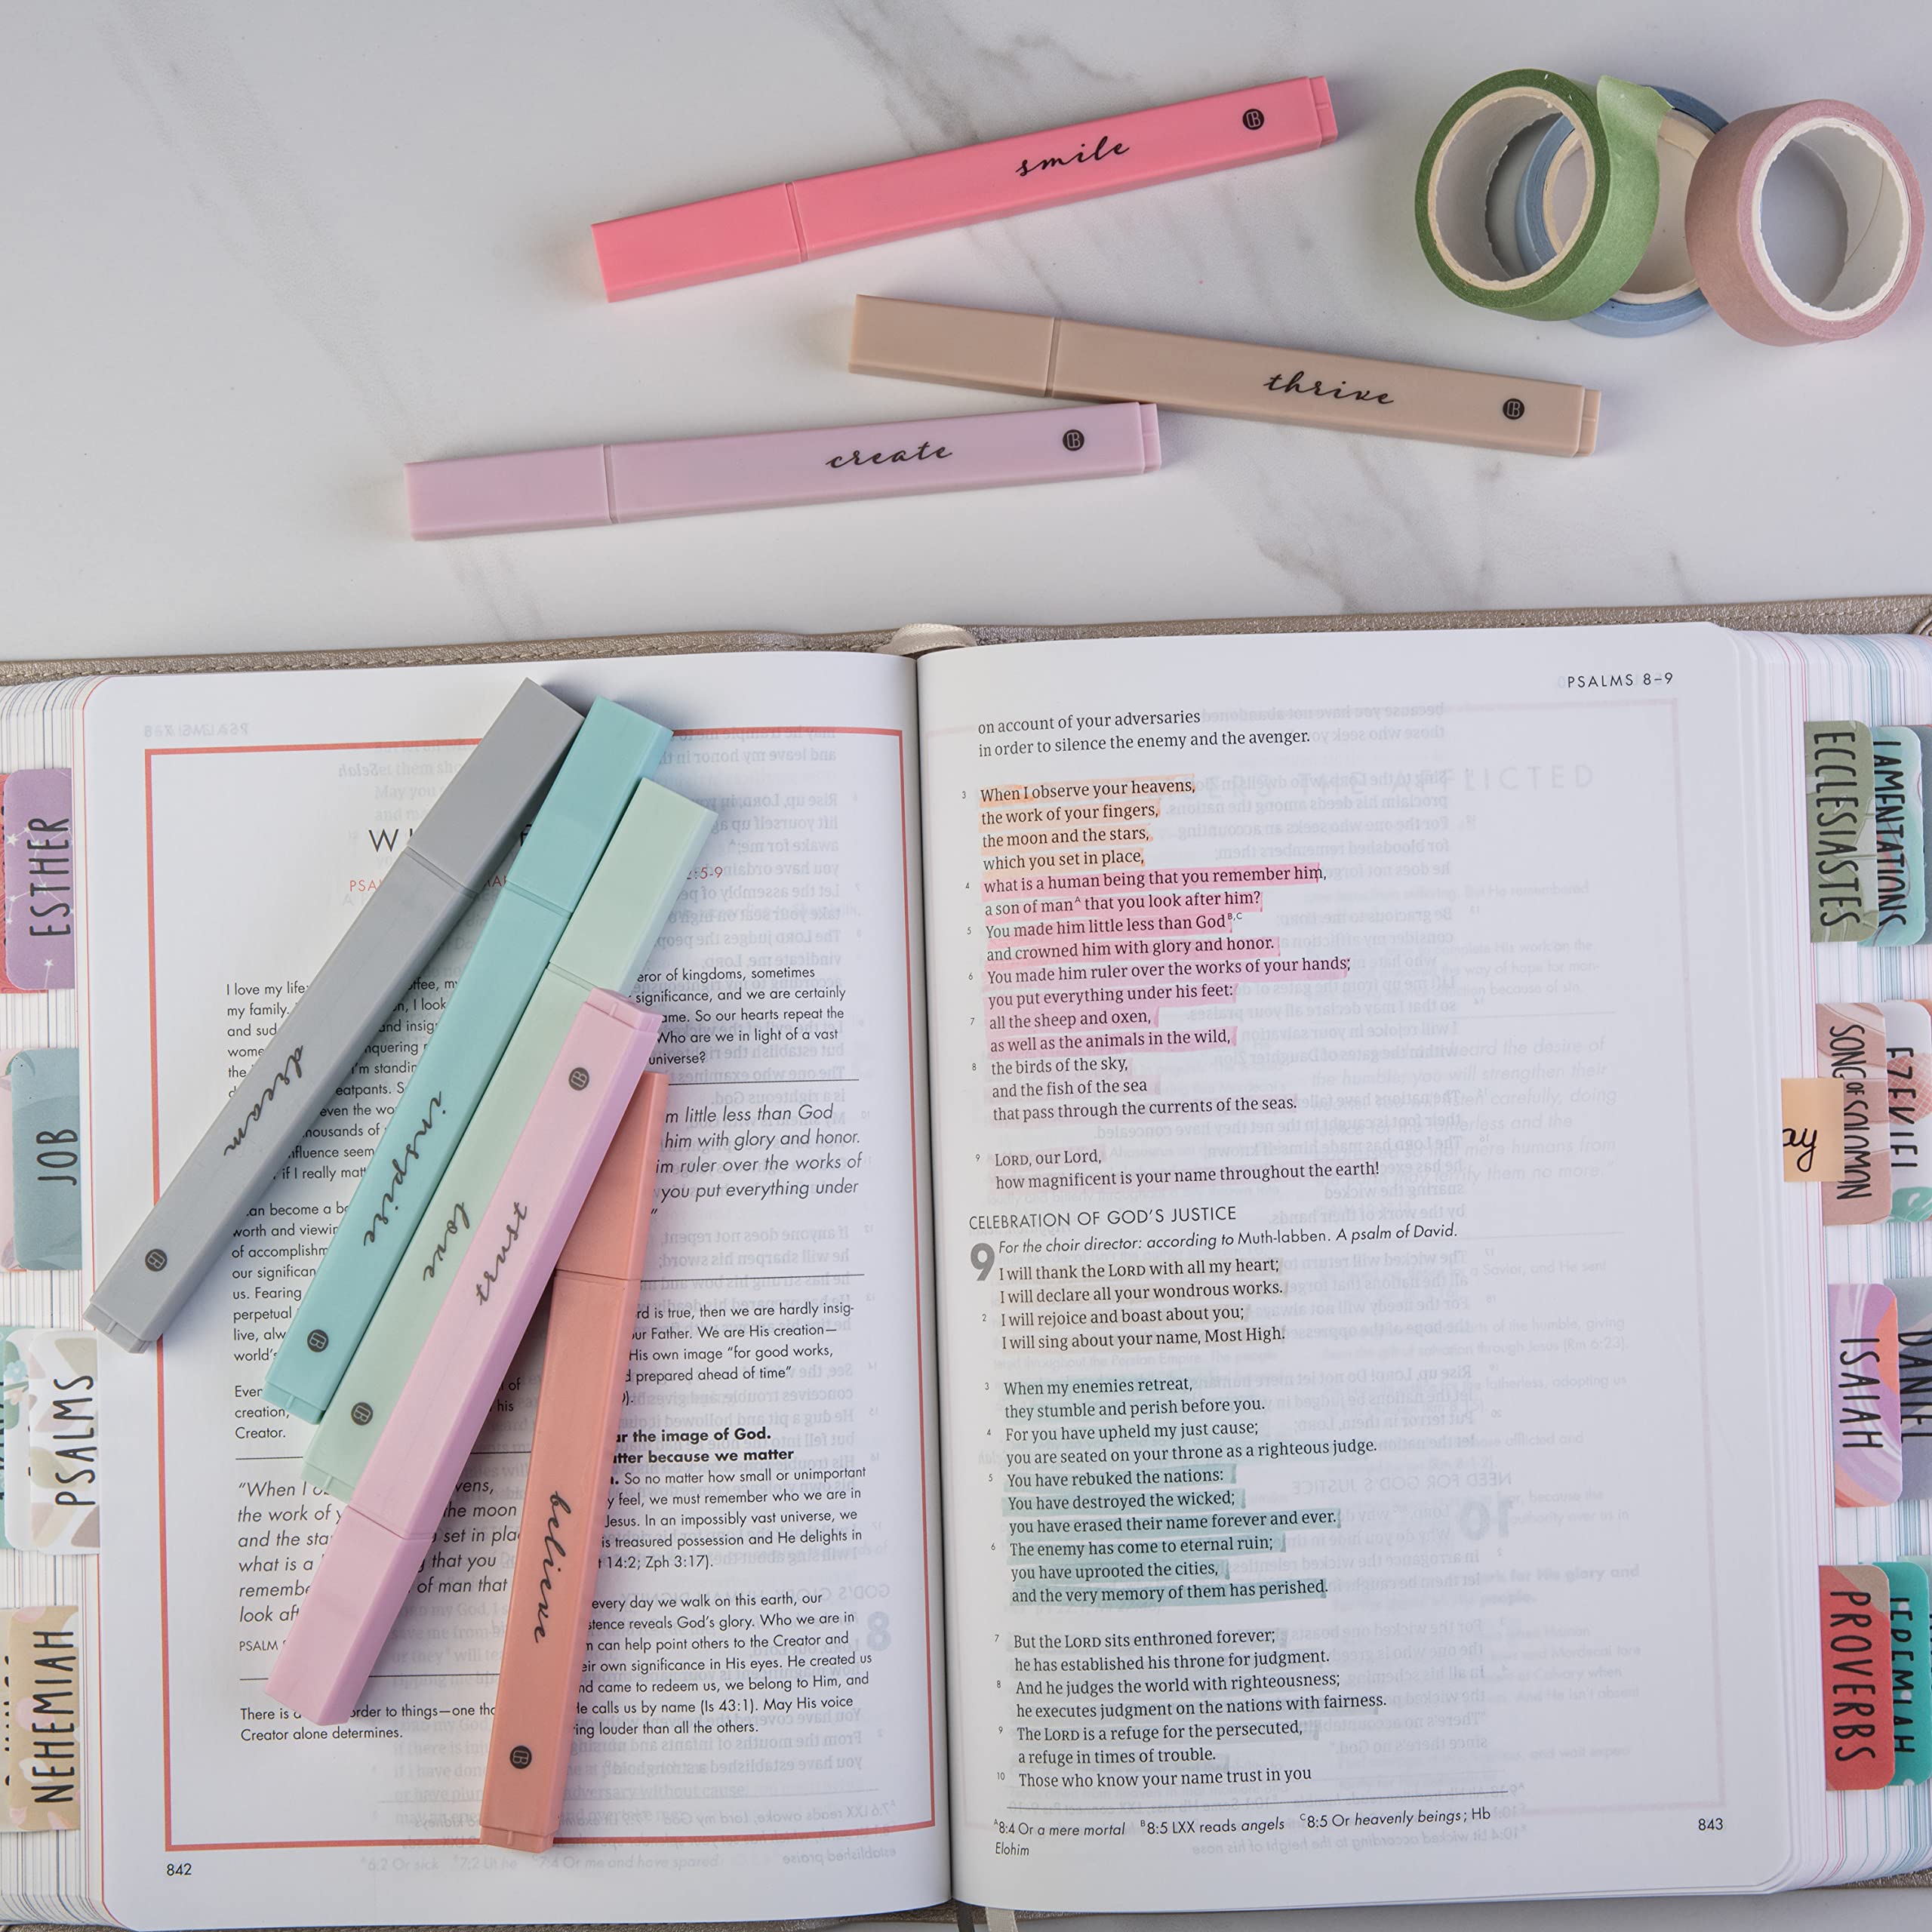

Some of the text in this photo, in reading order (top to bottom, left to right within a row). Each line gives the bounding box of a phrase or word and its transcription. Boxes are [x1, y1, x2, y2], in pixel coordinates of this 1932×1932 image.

[1015, 136, 1130, 177] smile
[1263, 371, 1394, 405] thrive
[826, 441, 952, 469] create
[1567, 674, 1634, 688] PSALMS
[978, 709, 1201, 734] on account of your adversaries
[961, 780, 1196, 803] 3 When I observe your heavens,
[1814, 732, 1862, 926] ECCLESIASTES
[27, 818, 71, 936] ESTHER
[965, 863, 1327, 894] 4 what is a human being that you remember him,
[226, 982, 283, 998] I love my
[227, 1001, 290, 1020] my family.
[1829, 1024, 1866, 1080] SONG
[223, 1045, 303, 1155] dream
[1846, 1082, 1865, 1095] OF
[685, 1102, 834, 1123] little less than God
[665, 1128, 860, 1152] him with glory and honor.
[36, 1129, 78, 1186] JOB
[363, 1091, 446, 1246] inspire
[969, 1205, 1237, 1230] CELEBRATION OF GOD'S JUSTICE
[423, 1201, 470, 1281] love
[998, 1221, 1457, 1254] For the choir director: according to Muth-labben. A psalm of David.
[475, 1201, 527, 1306] trust
[971, 1243, 995, 1281] 9
[998, 1267, 1004, 1281] I
[1006, 1266, 1032, 1281] will
[1035, 1264, 1078, 1280] thank
[1081, 1263, 1106, 1278] the
[1149, 1260, 1184, 1275] with
[1187, 1260, 1206, 1275] all
[1208, 1262, 1232, 1276] my
[1235, 1258, 1279, 1273] heart;
[232, 1286, 302, 1302] us. Fearing
[1838, 1338, 1883, 1447] ISAIAH
[234, 1406, 290, 1420] creation,
[53, 1375, 97, 1505] PSALMS
[235, 1426, 286, 1439] Creator.
[632, 1426, 771, 1445] the image of God.
[302, 1480, 307, 1496] I
[624, 1466, 866, 1485] So no matter how small or unimportant
[614, 1527, 862, 1551] treasured possession and He delights in
[991, 1535, 1273, 1558] 6 The enemy has come to eternal ruin;
[534, 1491, 571, 1643] believe
[239, 1640, 278, 1652] PSALM
[1830, 1592, 1875, 1761] PROVERBS
[31, 1632, 76, 1803] NEHEMIAH
[241, 1725, 403, 1742] Creator alone determines.
[997, 1767, 1312, 1789] 10 Those who know your name trust in you
[1018, 1822, 1034, 1835] Or
[1037, 1826, 1045, 1836] a
[1049, 1826, 1080, 1836] mere
[1084, 1821, 1126, 1836] mortal
[1172, 1820, 1195, 1834] LXX
[1199, 1818, 1237, 1833] reads
[1241, 1816, 1285, 1835] angels
[1331, 1814, 1350, 1827] Or
[1354, 1809, 1414, 1828] heavenly
[1417, 1809, 1467, 1826] beings;
[1472, 1806, 1491, 1820] Hb
[1698, 1817, 1724, 1831] 843
[995, 1841, 1029, 1857] Elohim
[166, 1863, 192, 1876] 842
